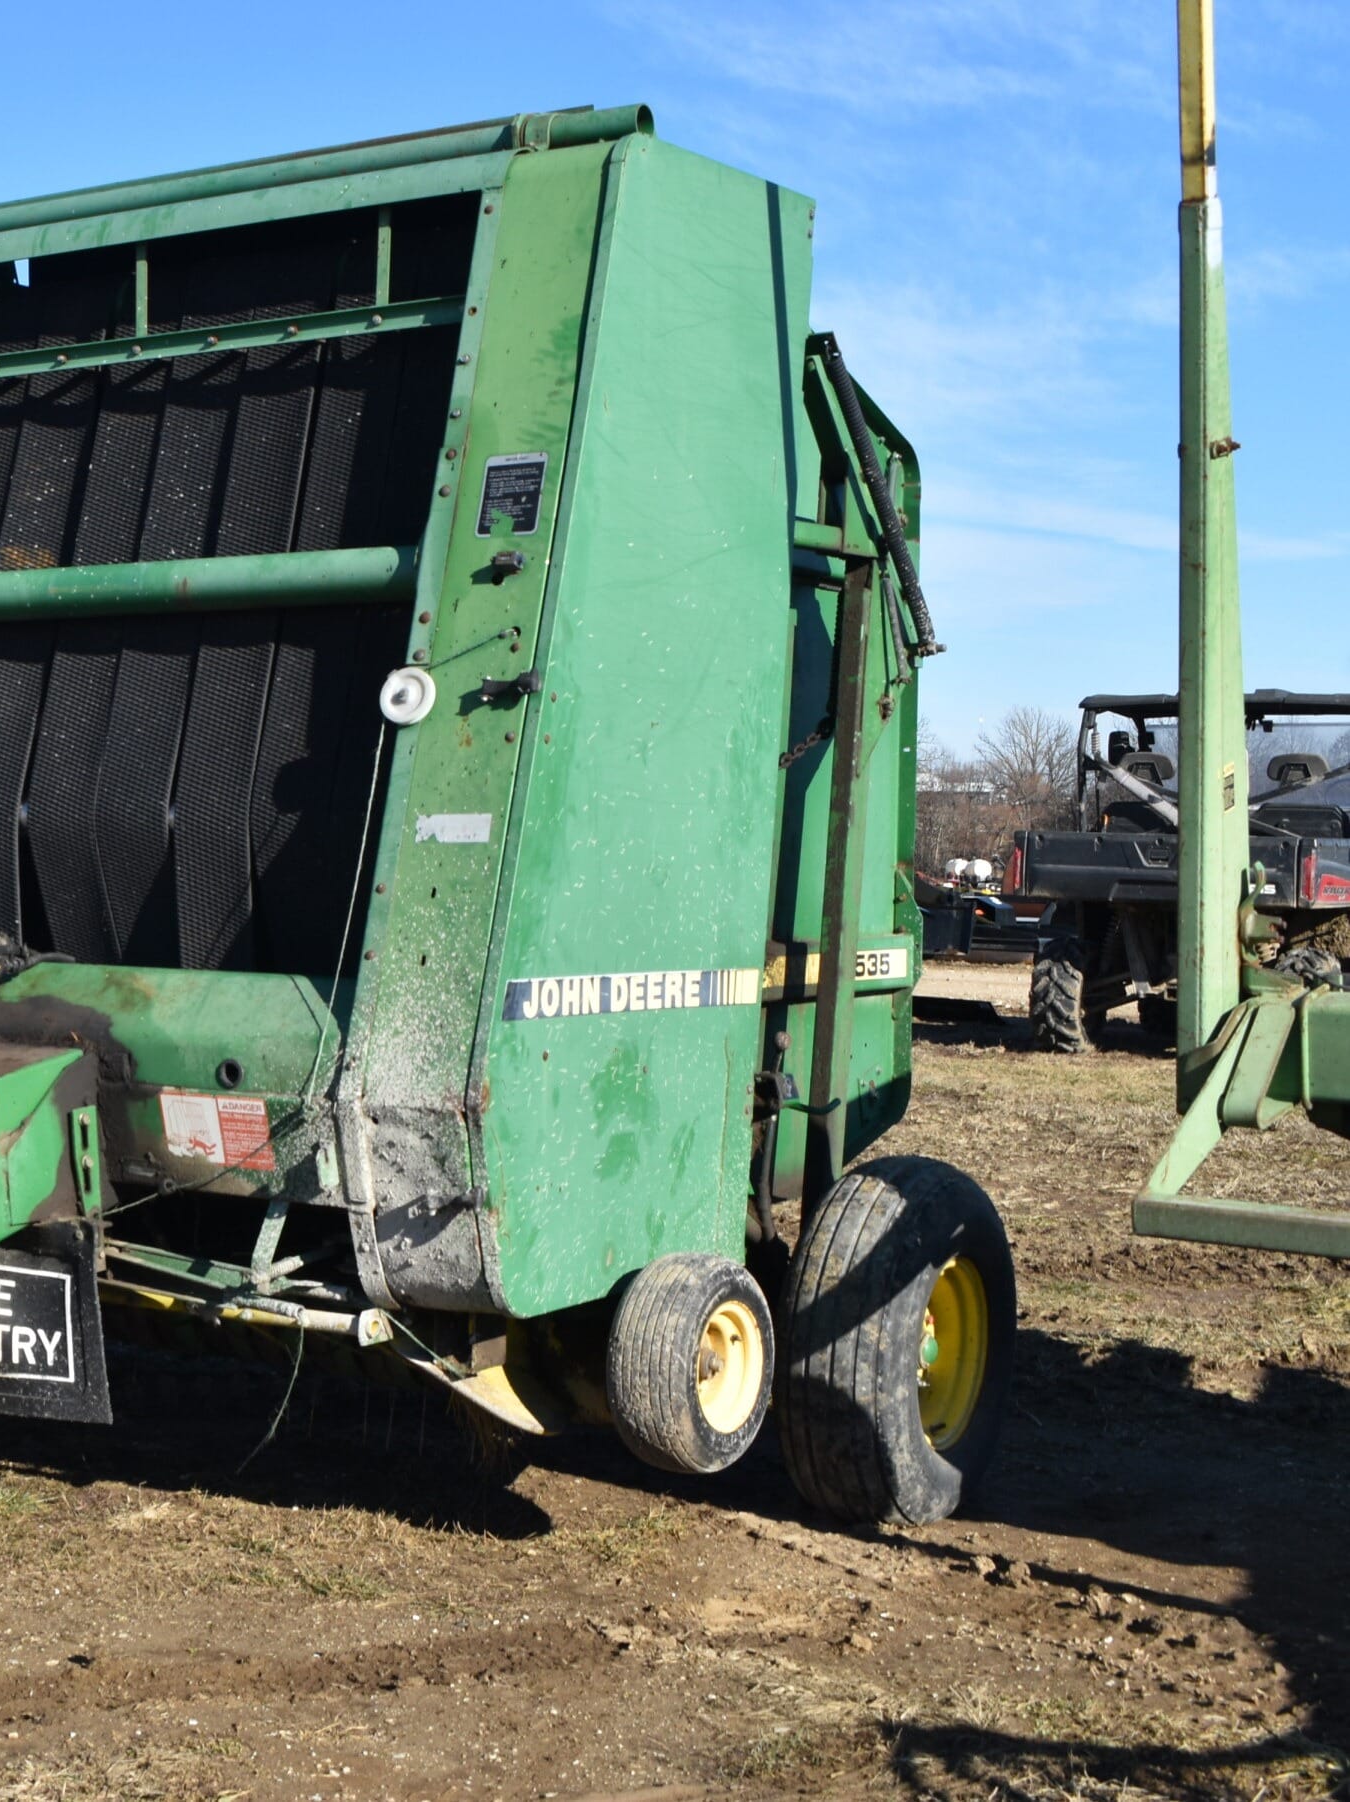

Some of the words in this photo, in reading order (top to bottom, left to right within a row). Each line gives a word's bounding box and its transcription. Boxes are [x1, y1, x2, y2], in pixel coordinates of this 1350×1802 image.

[855, 953, 890, 977] 535
[523, 976, 601, 1019] JOHN
[610, 972, 701, 1013] DEERE
[228, 1102, 263, 1113] DANGER
